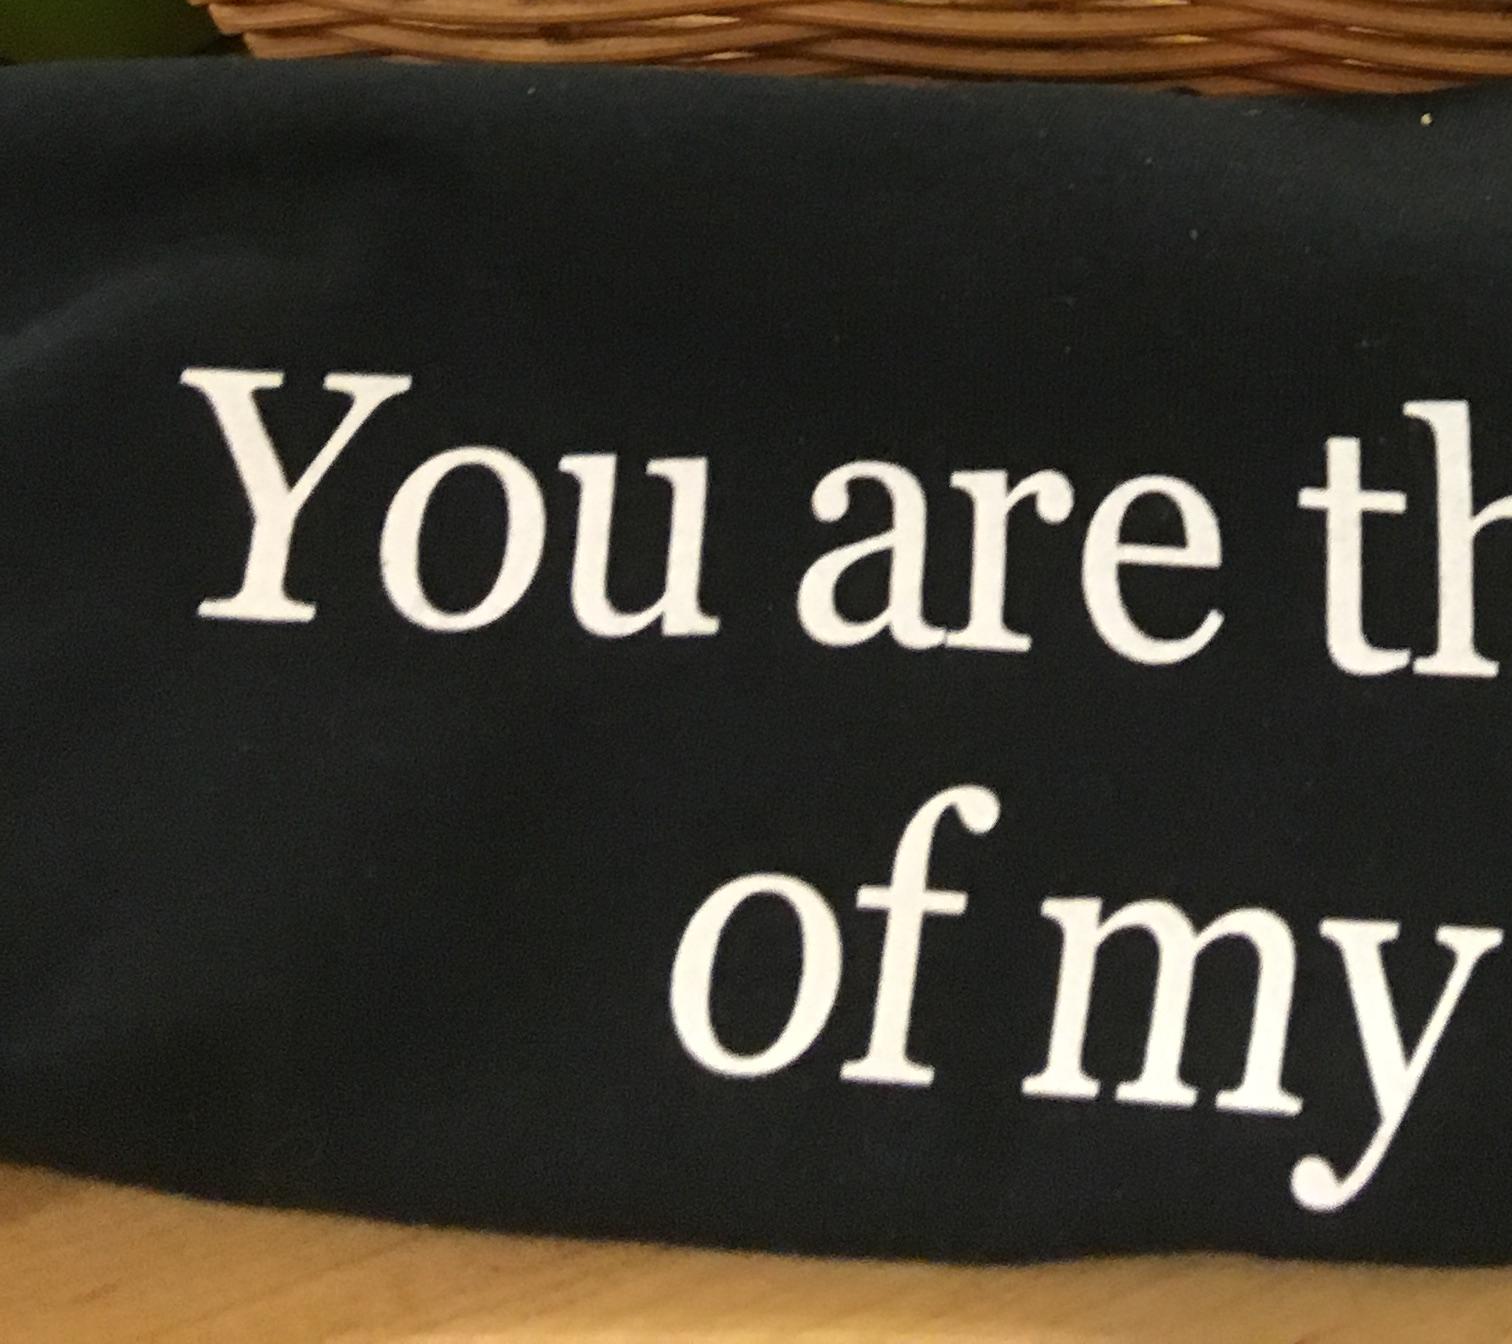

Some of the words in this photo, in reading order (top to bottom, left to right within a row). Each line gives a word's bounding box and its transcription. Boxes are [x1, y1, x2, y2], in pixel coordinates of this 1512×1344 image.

[181, 369, 718, 636] You
[798, 461, 1223, 664] are
[671, 786, 999, 1085] of
[1023, 898, 1502, 1210] my
